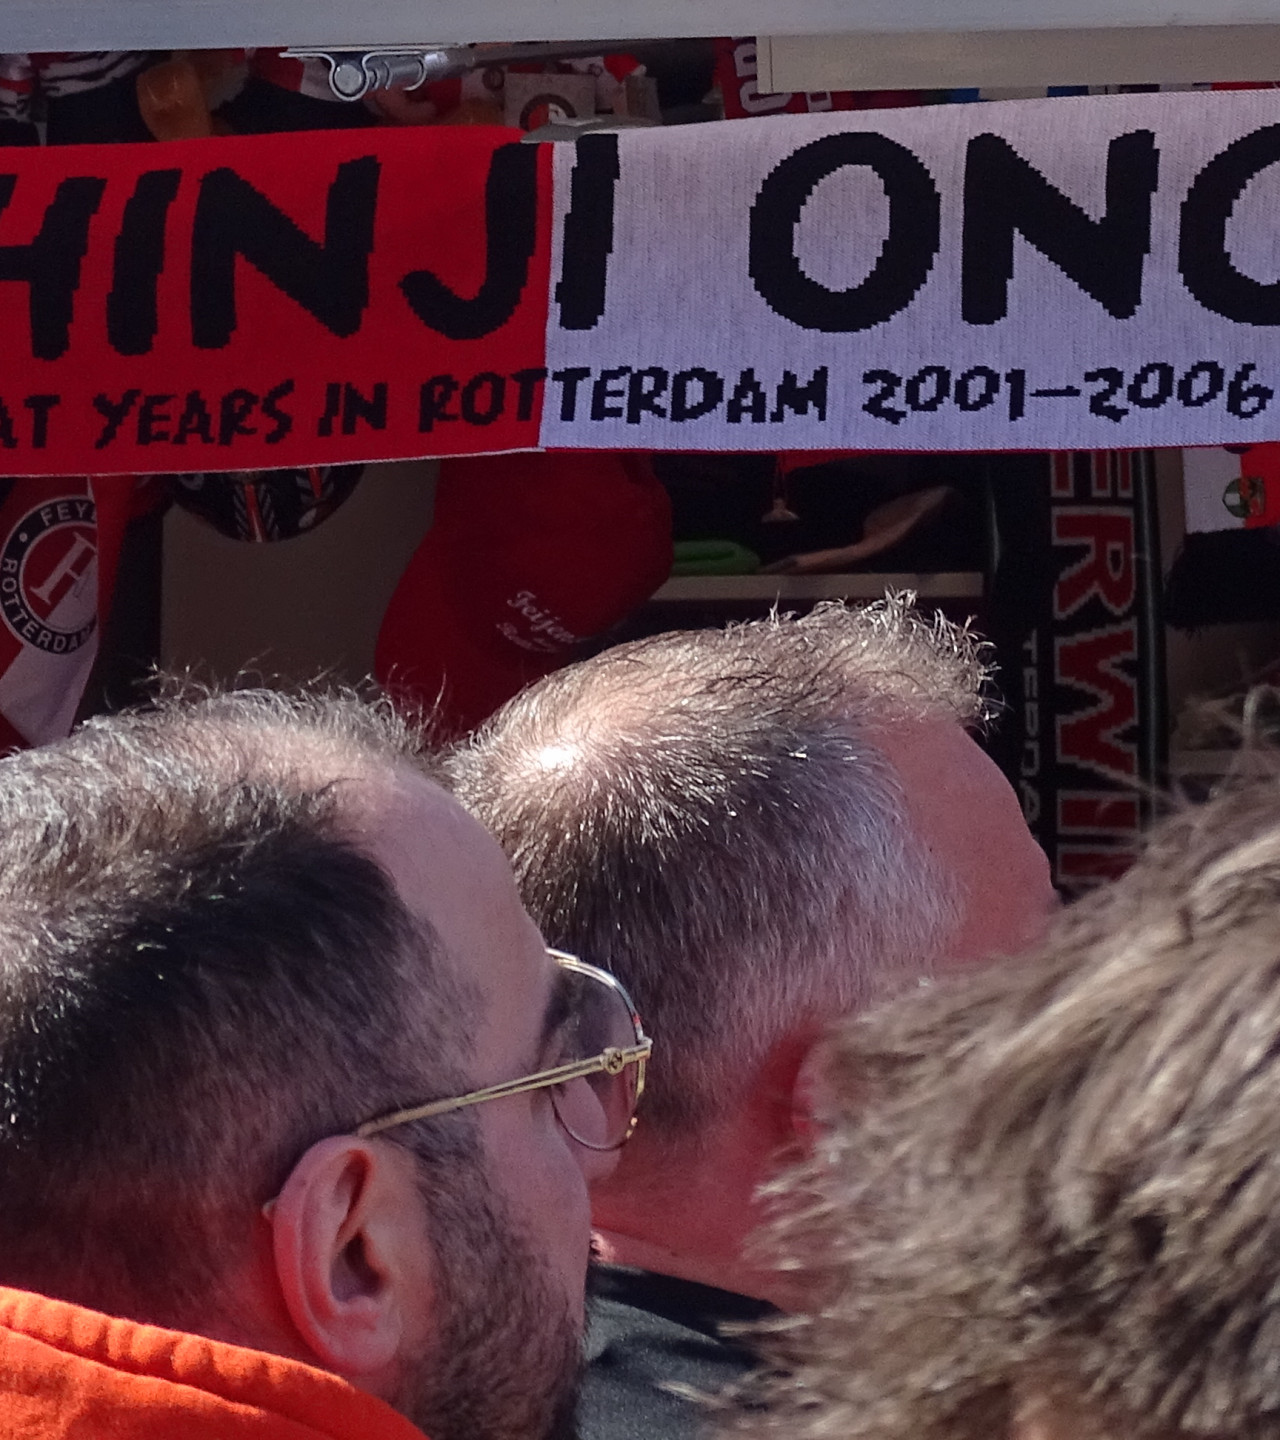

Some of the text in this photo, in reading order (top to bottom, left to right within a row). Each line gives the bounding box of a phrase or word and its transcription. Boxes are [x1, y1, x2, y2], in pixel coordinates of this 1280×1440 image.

[92, 380, 294, 450] YEARS
[317, 382, 388, 438] IN
[418, 366, 828, 432] ROTTERDAM
